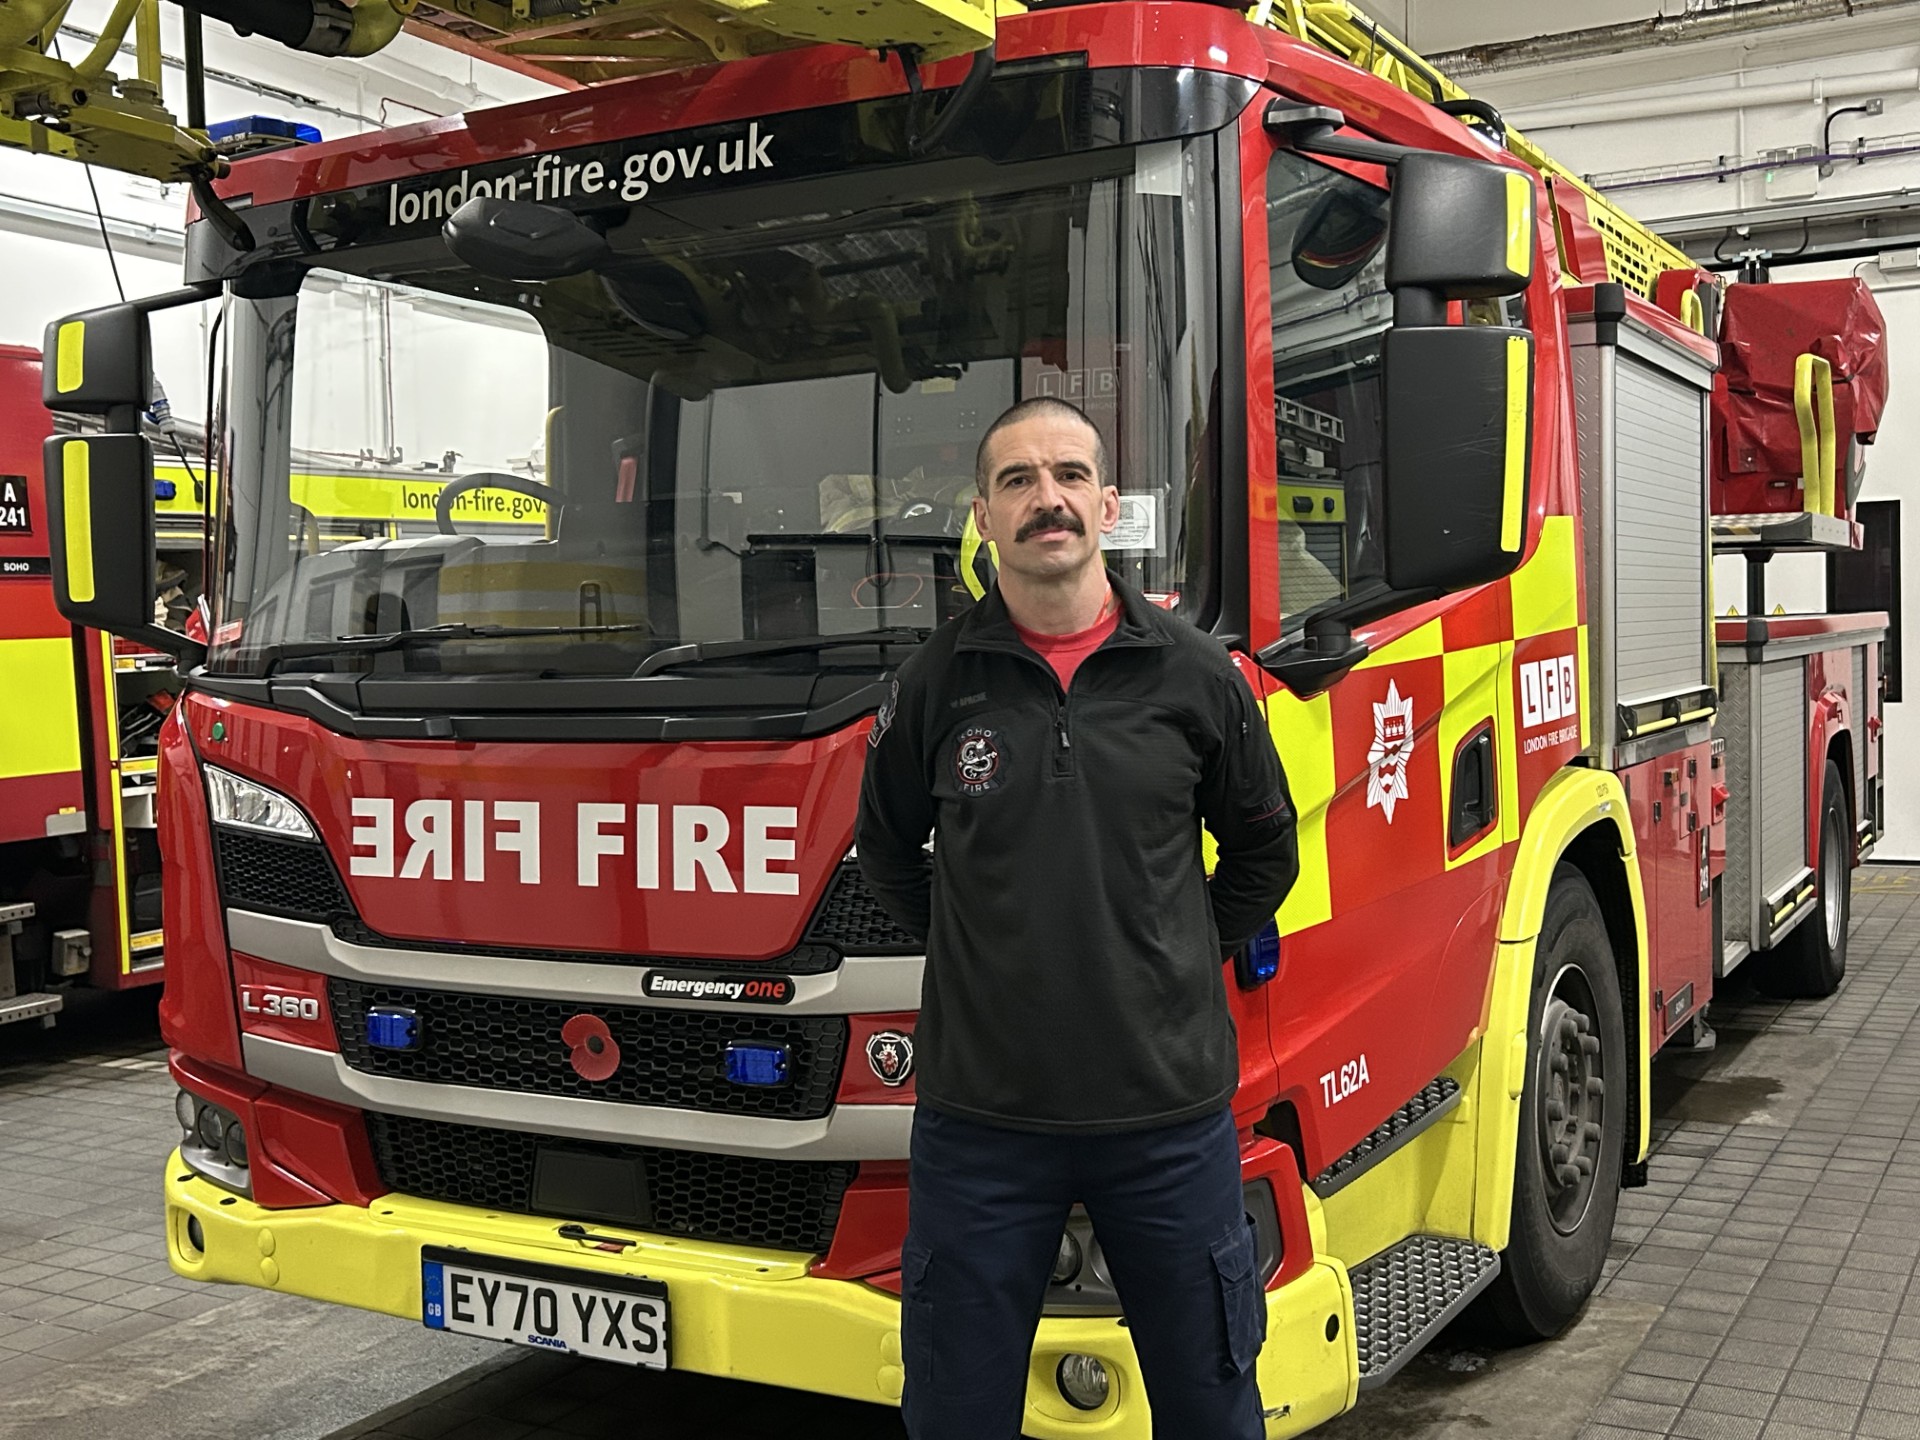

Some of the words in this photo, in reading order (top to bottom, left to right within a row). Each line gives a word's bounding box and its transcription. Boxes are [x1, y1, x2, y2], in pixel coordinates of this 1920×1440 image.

[4, 482, 17, 502] A
[0, 506, 26, 527] 241
[3, 562, 30, 572] SOHO
[1523, 662, 1574, 719] LFB
[1523, 733, 1548, 755] LONDON
[1547, 730, 1559, 747] FIRE
[1558, 724, 1578, 744] BRIGADE
[963, 781, 990, 793] FIRE
[577, 802, 800, 895] FIRE
[1319, 1053, 1370, 1109] TL62A
[427, 1302, 442, 1317] GB
[451, 1273, 559, 1337] EY70
[572, 1292, 658, 1354] YXS
[527, 1334, 567, 1349] SCANIA
